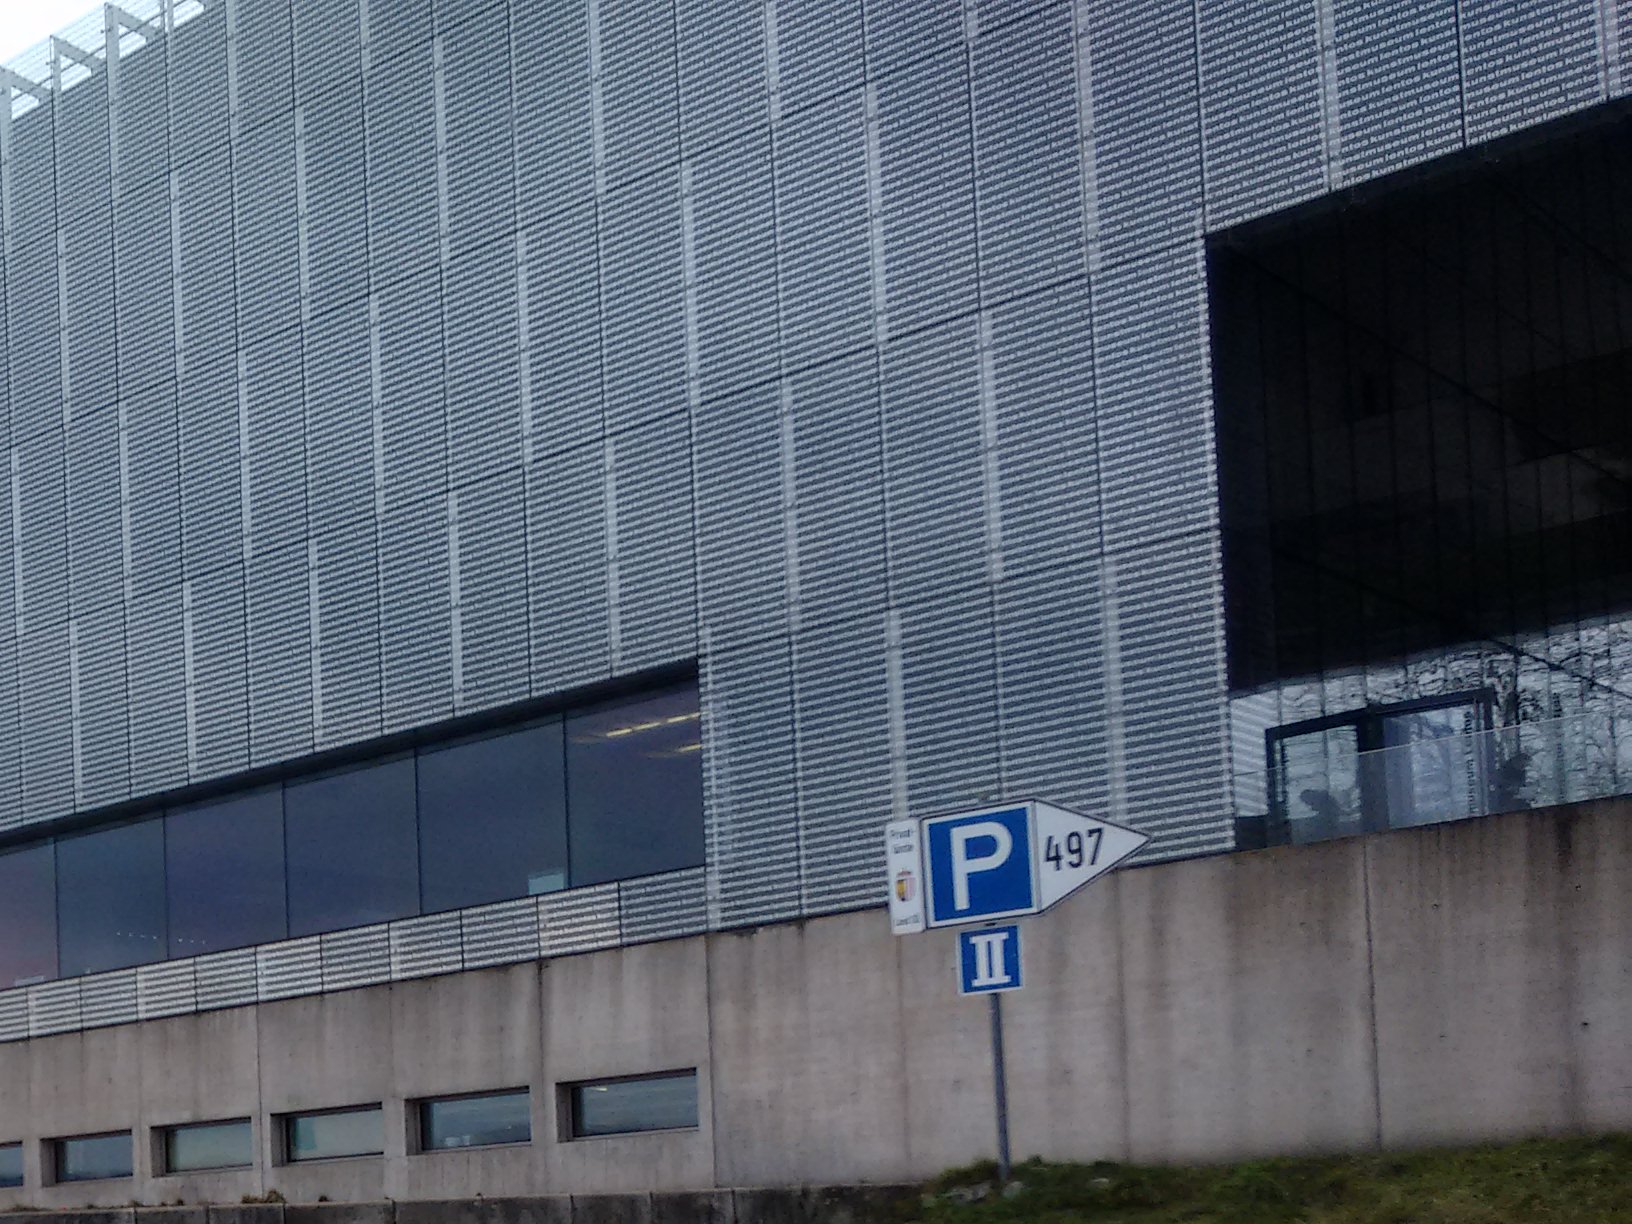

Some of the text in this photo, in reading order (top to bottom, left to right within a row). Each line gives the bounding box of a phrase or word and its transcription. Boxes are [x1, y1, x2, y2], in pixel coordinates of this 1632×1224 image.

[950, 821, 1013, 911] P
[1043, 827, 1105, 872] 497
[969, 932, 1011, 987] II
